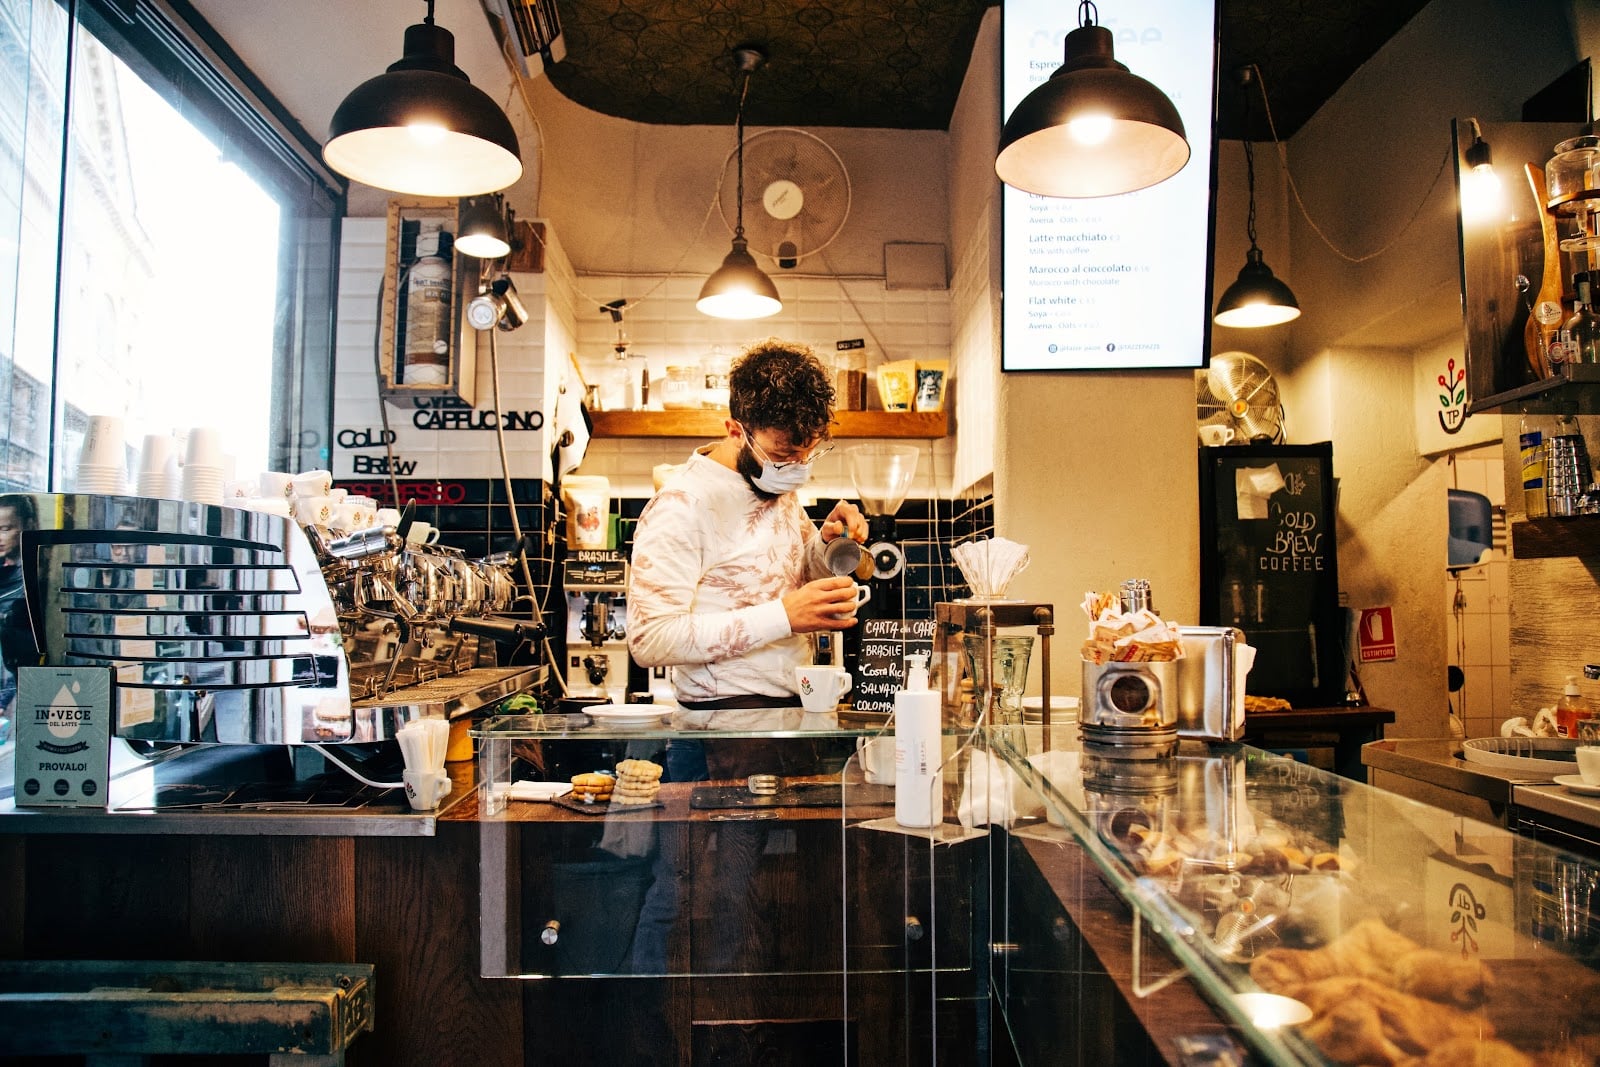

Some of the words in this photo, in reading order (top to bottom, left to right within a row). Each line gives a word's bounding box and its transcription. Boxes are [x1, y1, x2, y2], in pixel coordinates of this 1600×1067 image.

[1029, 233, 1053, 243] Latte
[1056, 232, 1107, 242] macchiato
[1046, 247, 1065, 255] with
[1065, 246, 1090, 254] coffee
[1029, 265, 1070, 274] Marocco
[1071, 264, 1081, 273] al
[1083, 264, 1132, 273] cioccolato
[1063, 278, 1081, 286] with
[1082, 278, 1120, 286] chocolate
[1028, 296, 1046, 305] Flat
[1049, 296, 1077, 305] white
[1028, 310, 1048, 318] Soya
[353, 454, 418, 476] BREW
[335, 482, 466, 506] SPRESSO
[1265, 531, 1323, 557] BREW
[578, 550, 620, 563] BRASILE
[1260, 556, 1324, 571] COFFEE
[865, 621, 899, 638] CARTA
[866, 645, 902, 657] BRASILE
[1363, 648, 1394, 658] ESTINTORE
[39, 762, 87, 772] PROVALO!
